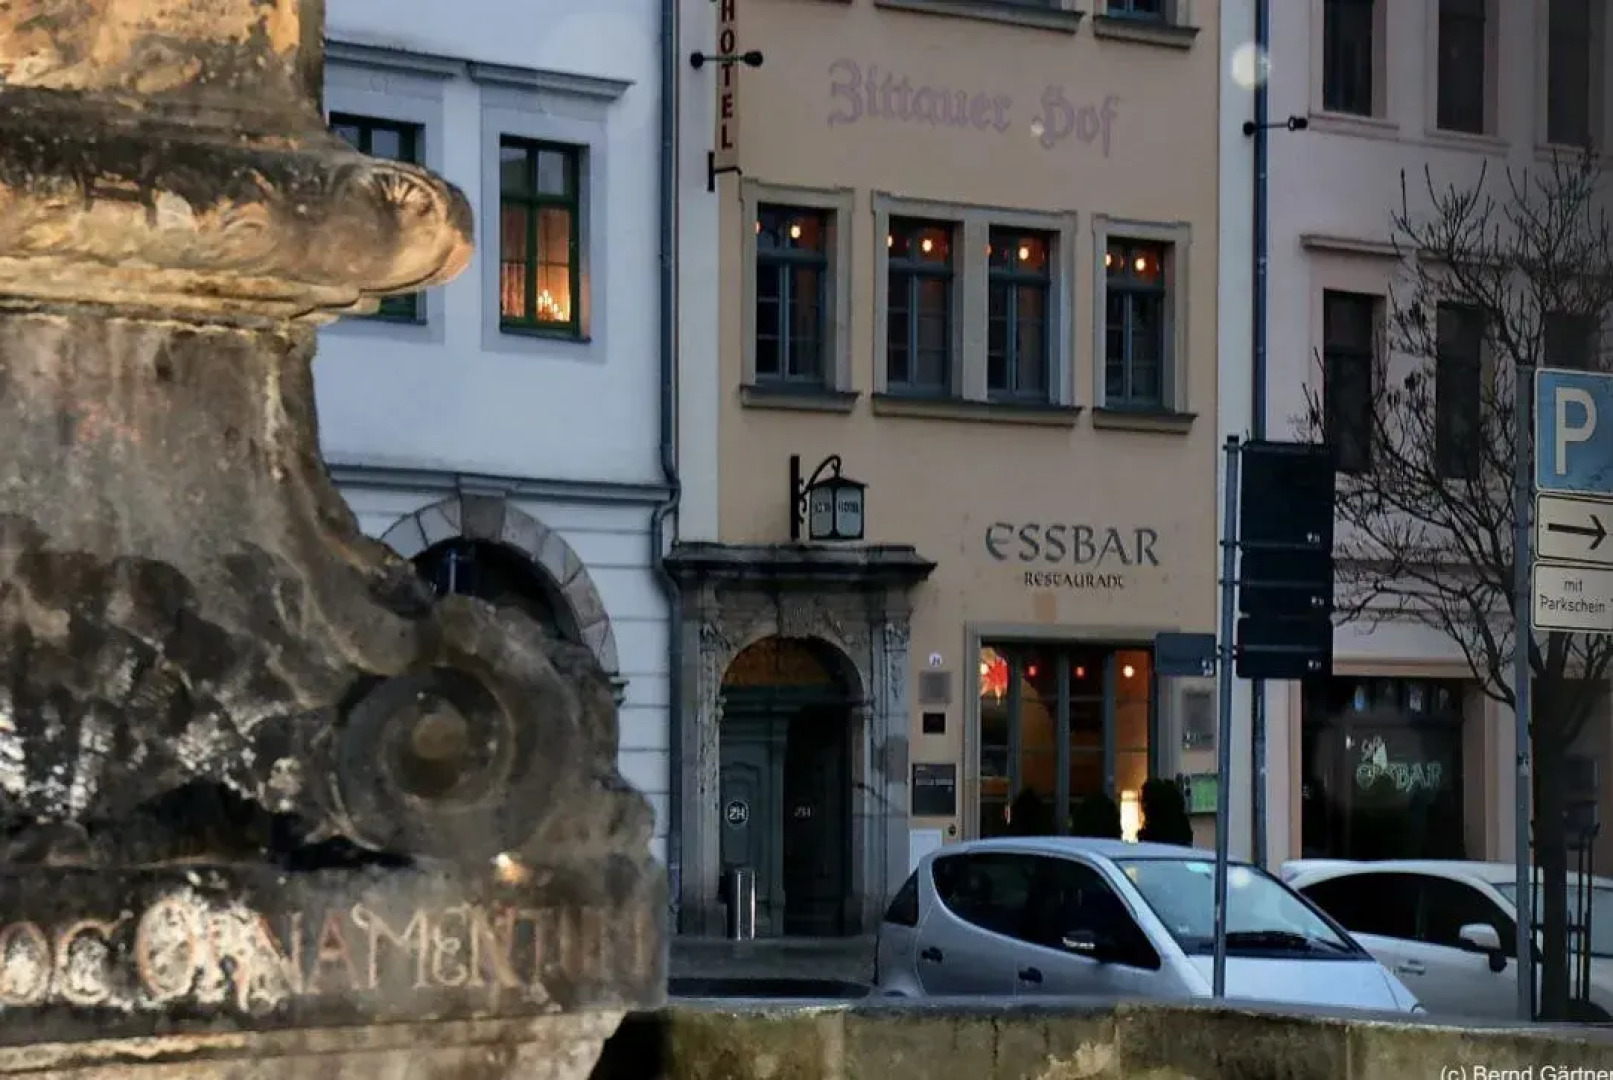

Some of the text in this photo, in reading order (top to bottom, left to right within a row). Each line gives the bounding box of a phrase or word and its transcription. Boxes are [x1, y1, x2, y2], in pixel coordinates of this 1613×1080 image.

[720, 0, 735, 149] HOTEL
[827, 57, 1120, 158] Zittauer Hof
[1554, 386, 1598, 476] P
[985, 521, 1160, 568] ESSBAR
[1024, 570, 1125, 590] RESTAURANT
[1539, 593, 1606, 614] Parkschein
[1563, 578, 1583, 593] mit
